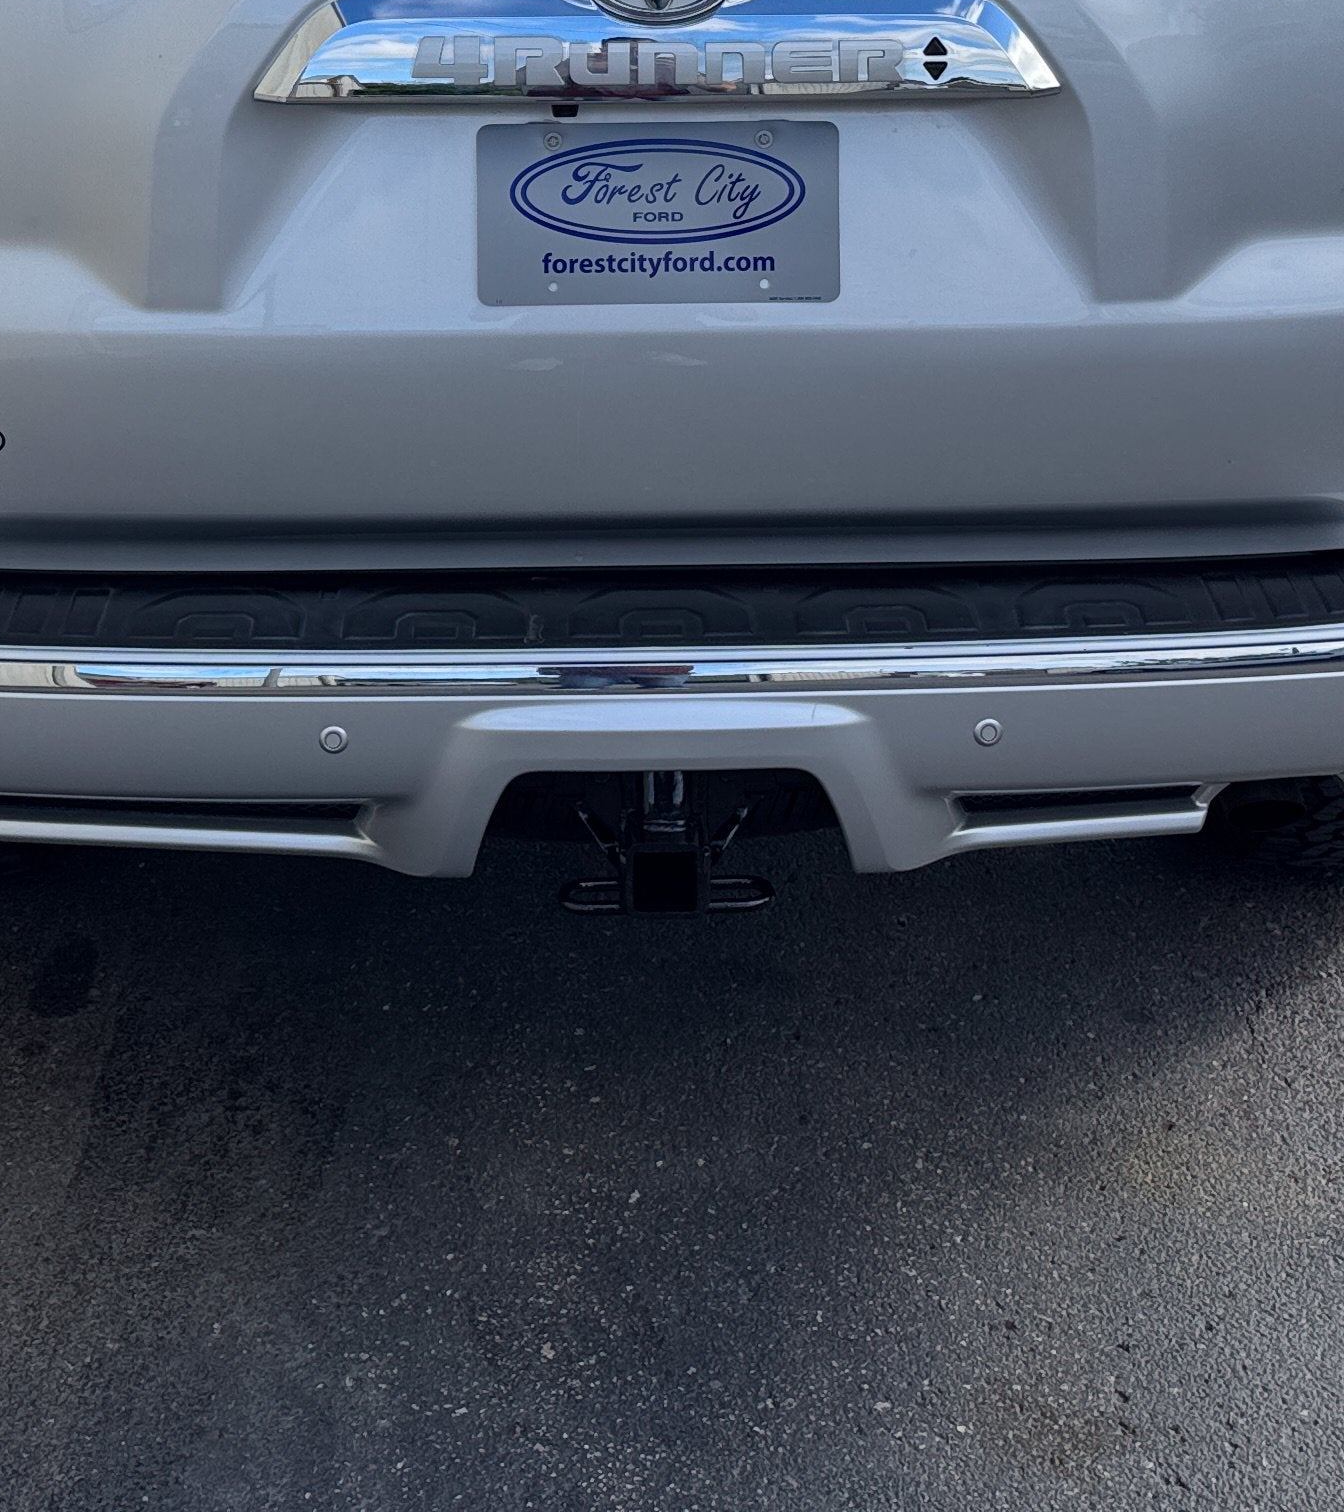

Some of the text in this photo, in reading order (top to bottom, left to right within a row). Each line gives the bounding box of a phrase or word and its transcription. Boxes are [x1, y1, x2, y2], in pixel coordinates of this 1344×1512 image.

[560, 161, 762, 219] Forest City
[632, 211, 684, 223] FORD
[542, 250, 776, 279] forestcityford.com
